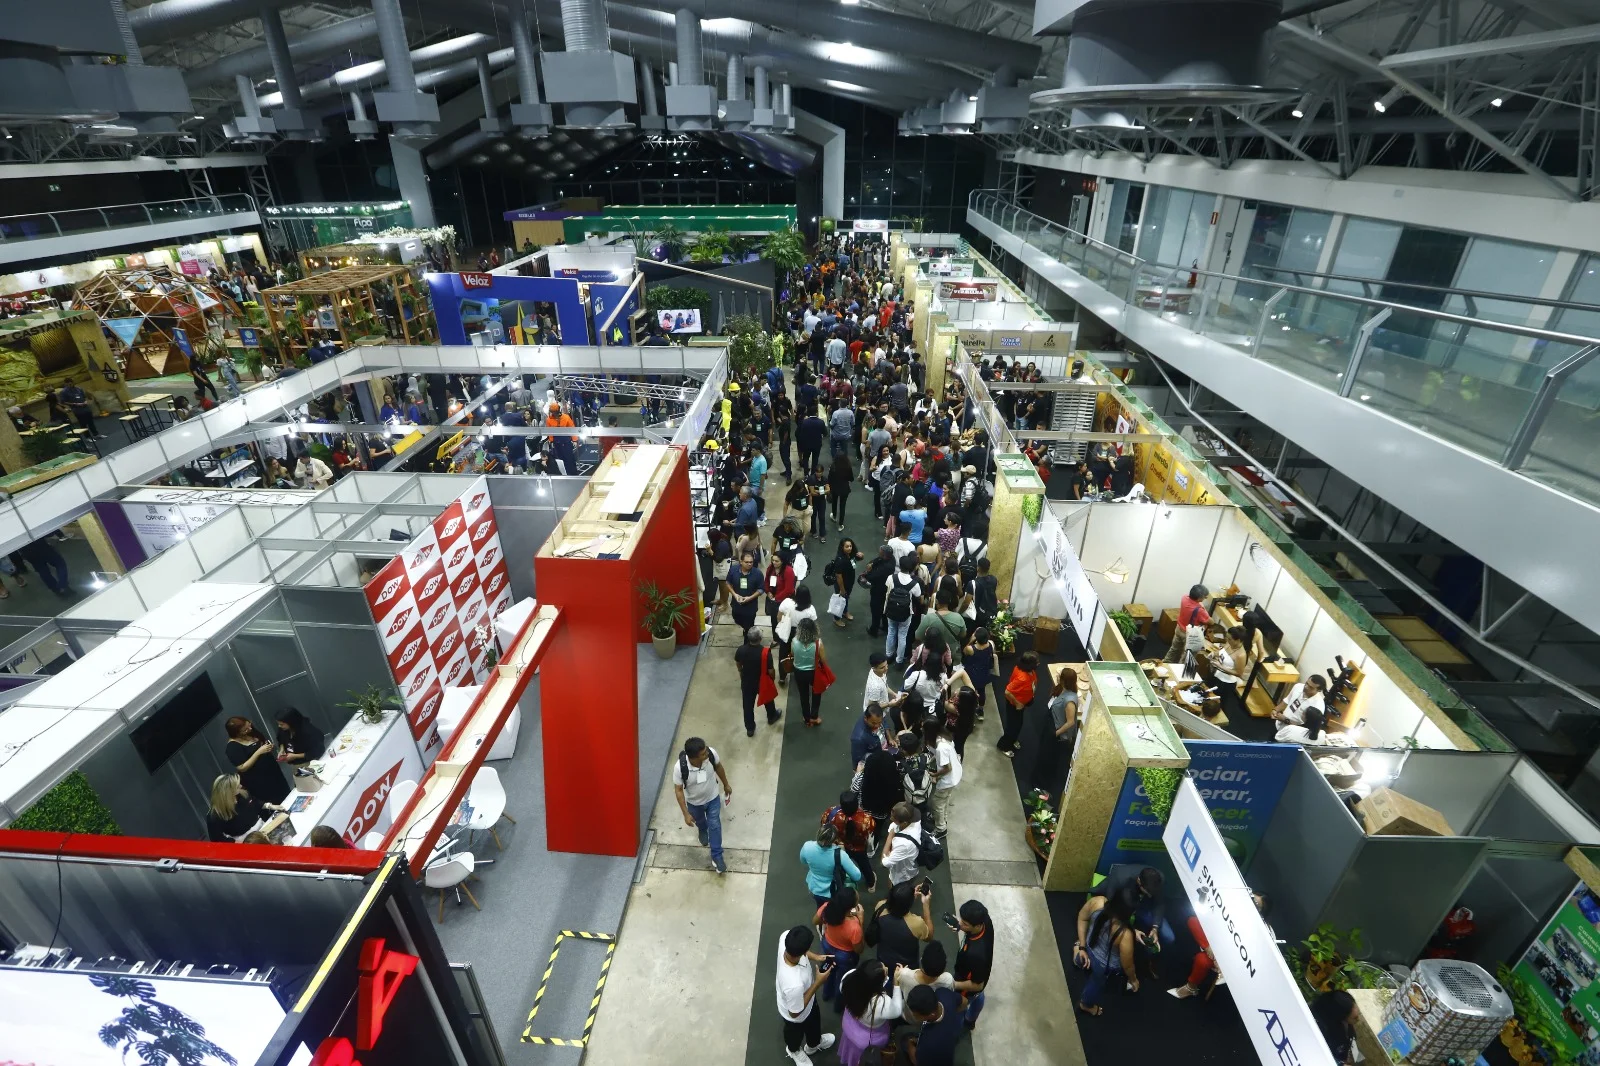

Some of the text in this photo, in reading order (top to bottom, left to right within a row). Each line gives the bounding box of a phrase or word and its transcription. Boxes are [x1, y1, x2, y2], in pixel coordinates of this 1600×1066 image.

[462, 275, 490, 286] Veloz
[11, 314, 88, 341] CASTANHAL
[445, 520, 460, 535] DOW
[477, 522, 490, 538] DOW
[452, 547, 466, 565] DOW
[483, 549, 496, 565] DOW
[381, 579, 399, 601] DOW
[424, 577, 440, 596] DOW
[460, 577, 474, 594] DOW
[490, 576, 502, 592] DOW
[432, 607, 448, 626] DOW
[466, 602, 480, 620] DOW
[392, 611, 410, 633] DOW
[402, 641, 419, 663] DOW
[440, 634, 455, 654] DOW
[450, 660, 464, 680] DOW
[412, 670, 428, 693] DOW
[421, 696, 438, 720] DOW
[429, 730, 440, 746] DO
[346, 773, 392, 844] DOW
[1124, 819, 1146, 828] Faça
[1201, 865, 1256, 978] SINDUSCON
[1577, 932, 1598, 954] Seguro
